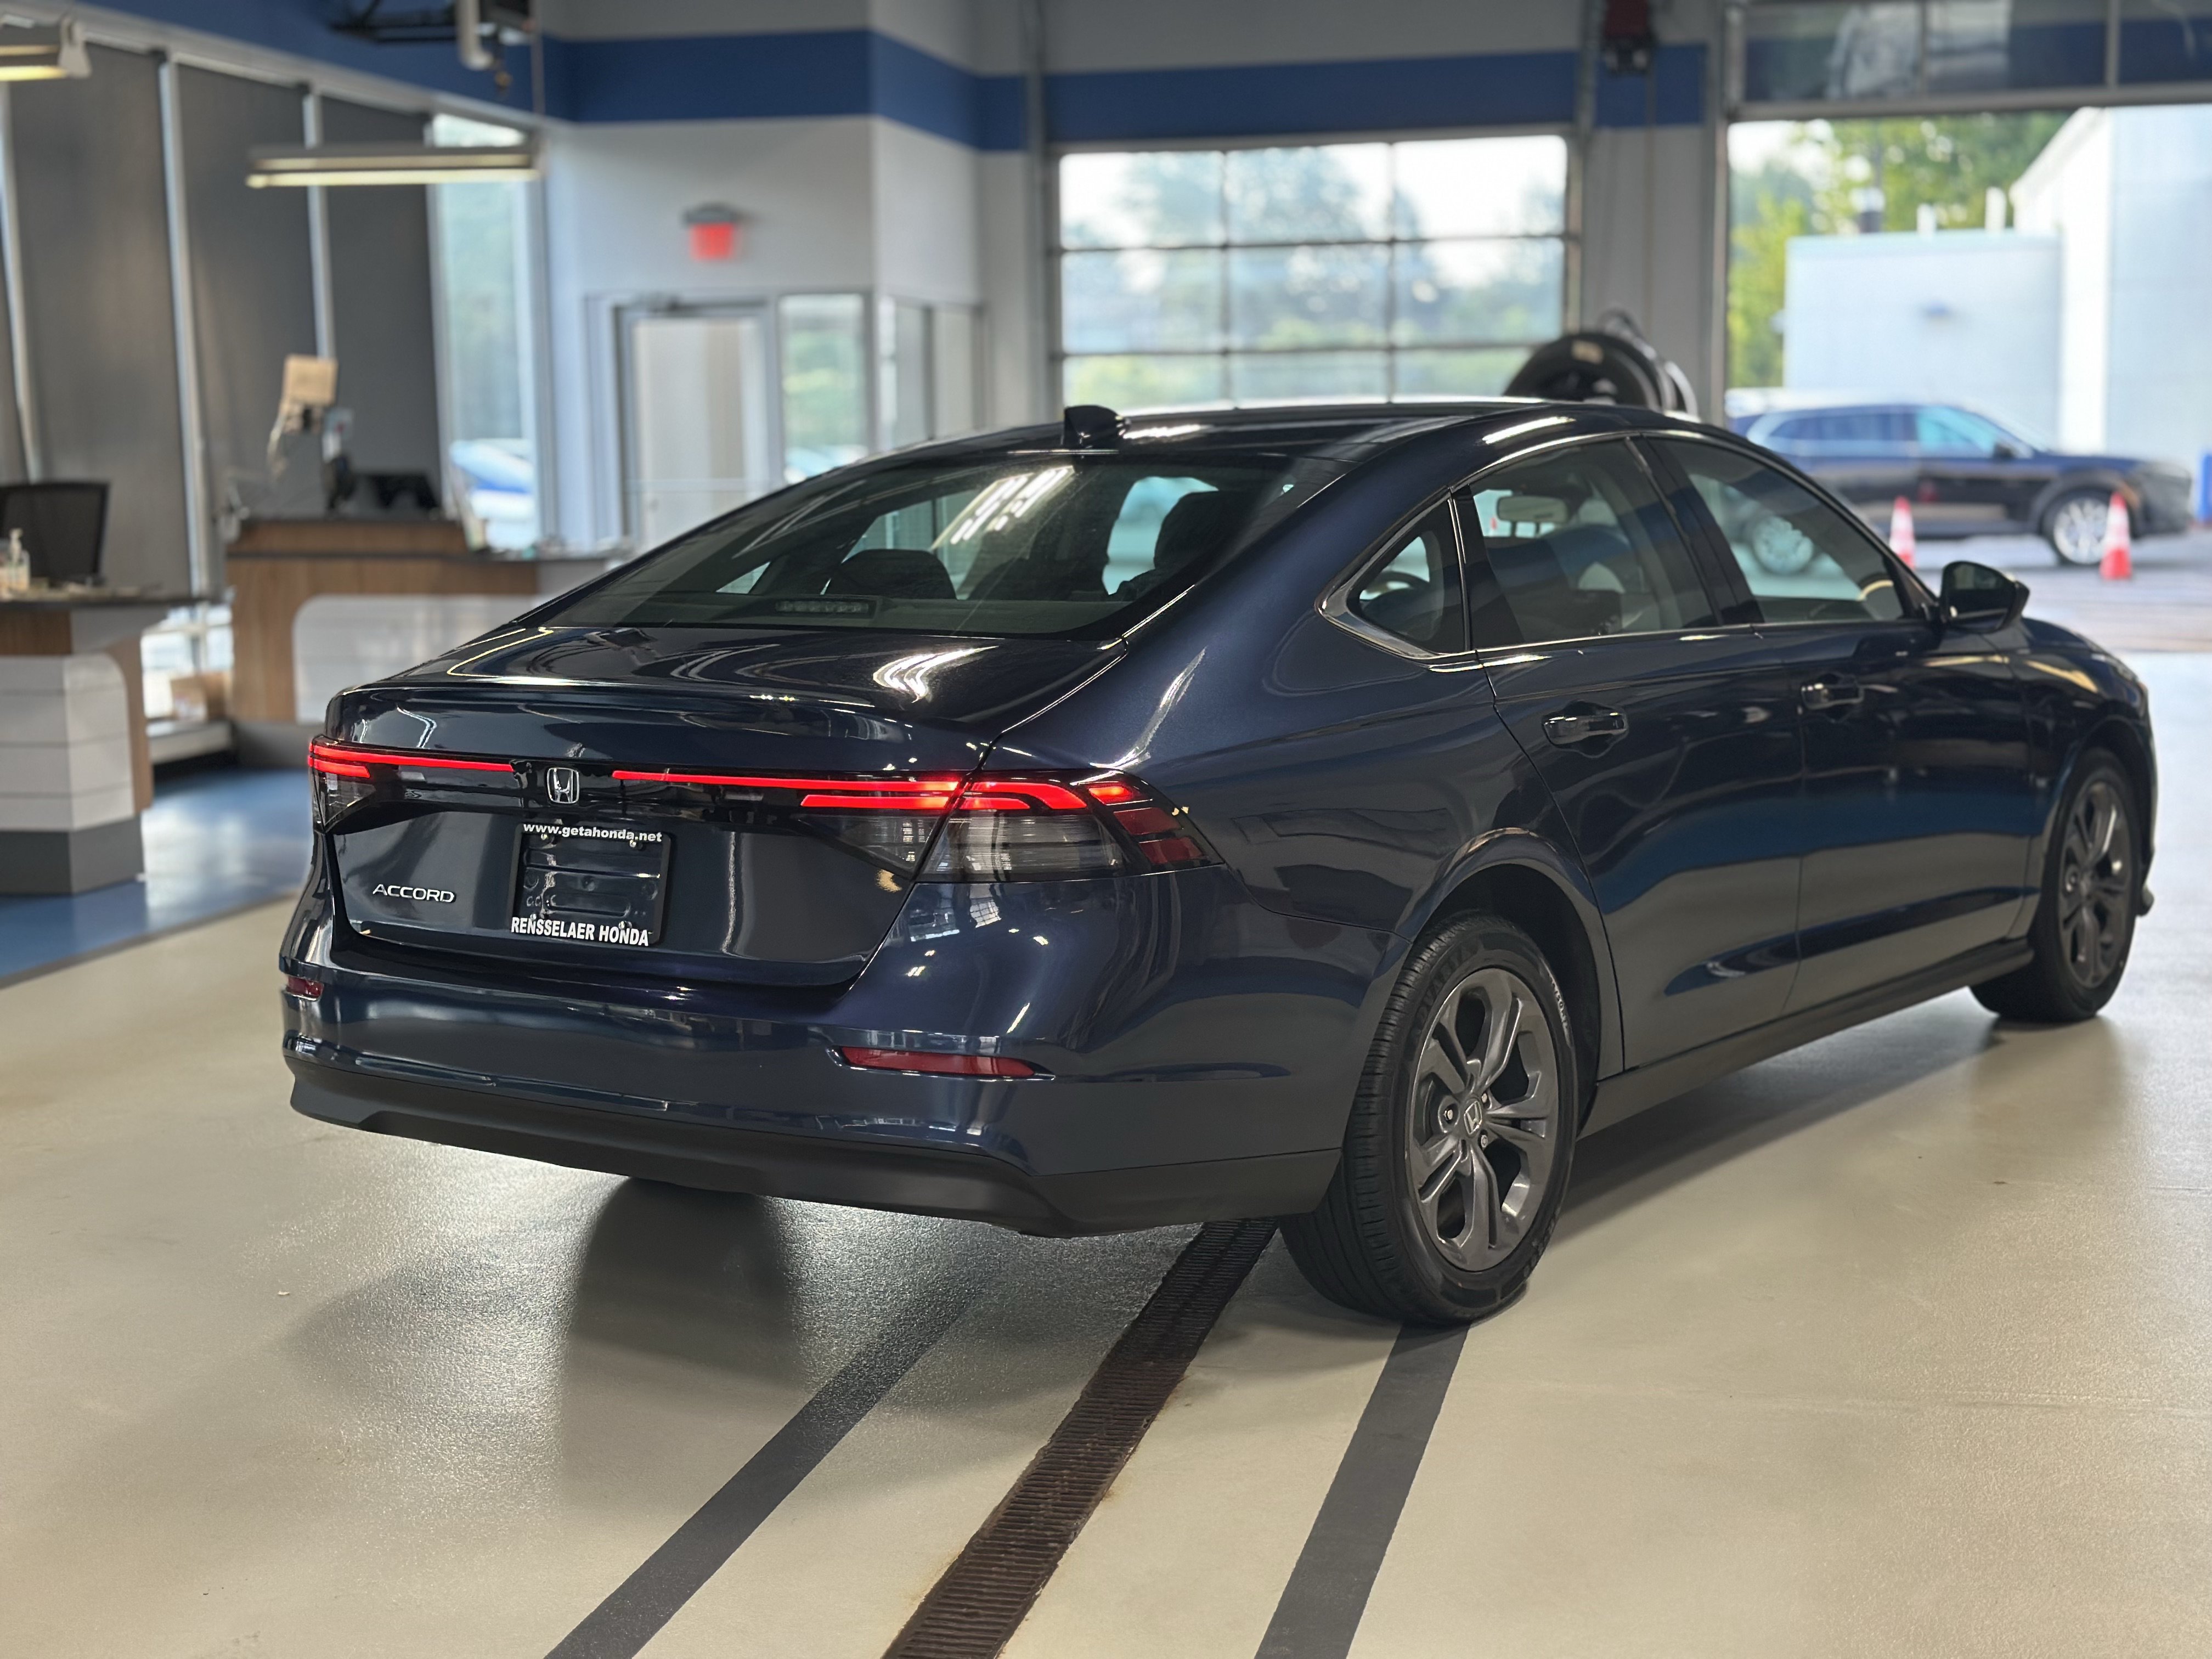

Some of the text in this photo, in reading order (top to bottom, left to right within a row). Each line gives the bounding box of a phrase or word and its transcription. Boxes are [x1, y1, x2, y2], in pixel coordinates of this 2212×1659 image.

[523, 823, 662, 842] www.getahonda.net
[373, 884, 455, 902] ACCORD
[511, 917, 649, 946] RENSSELAER HONDA
